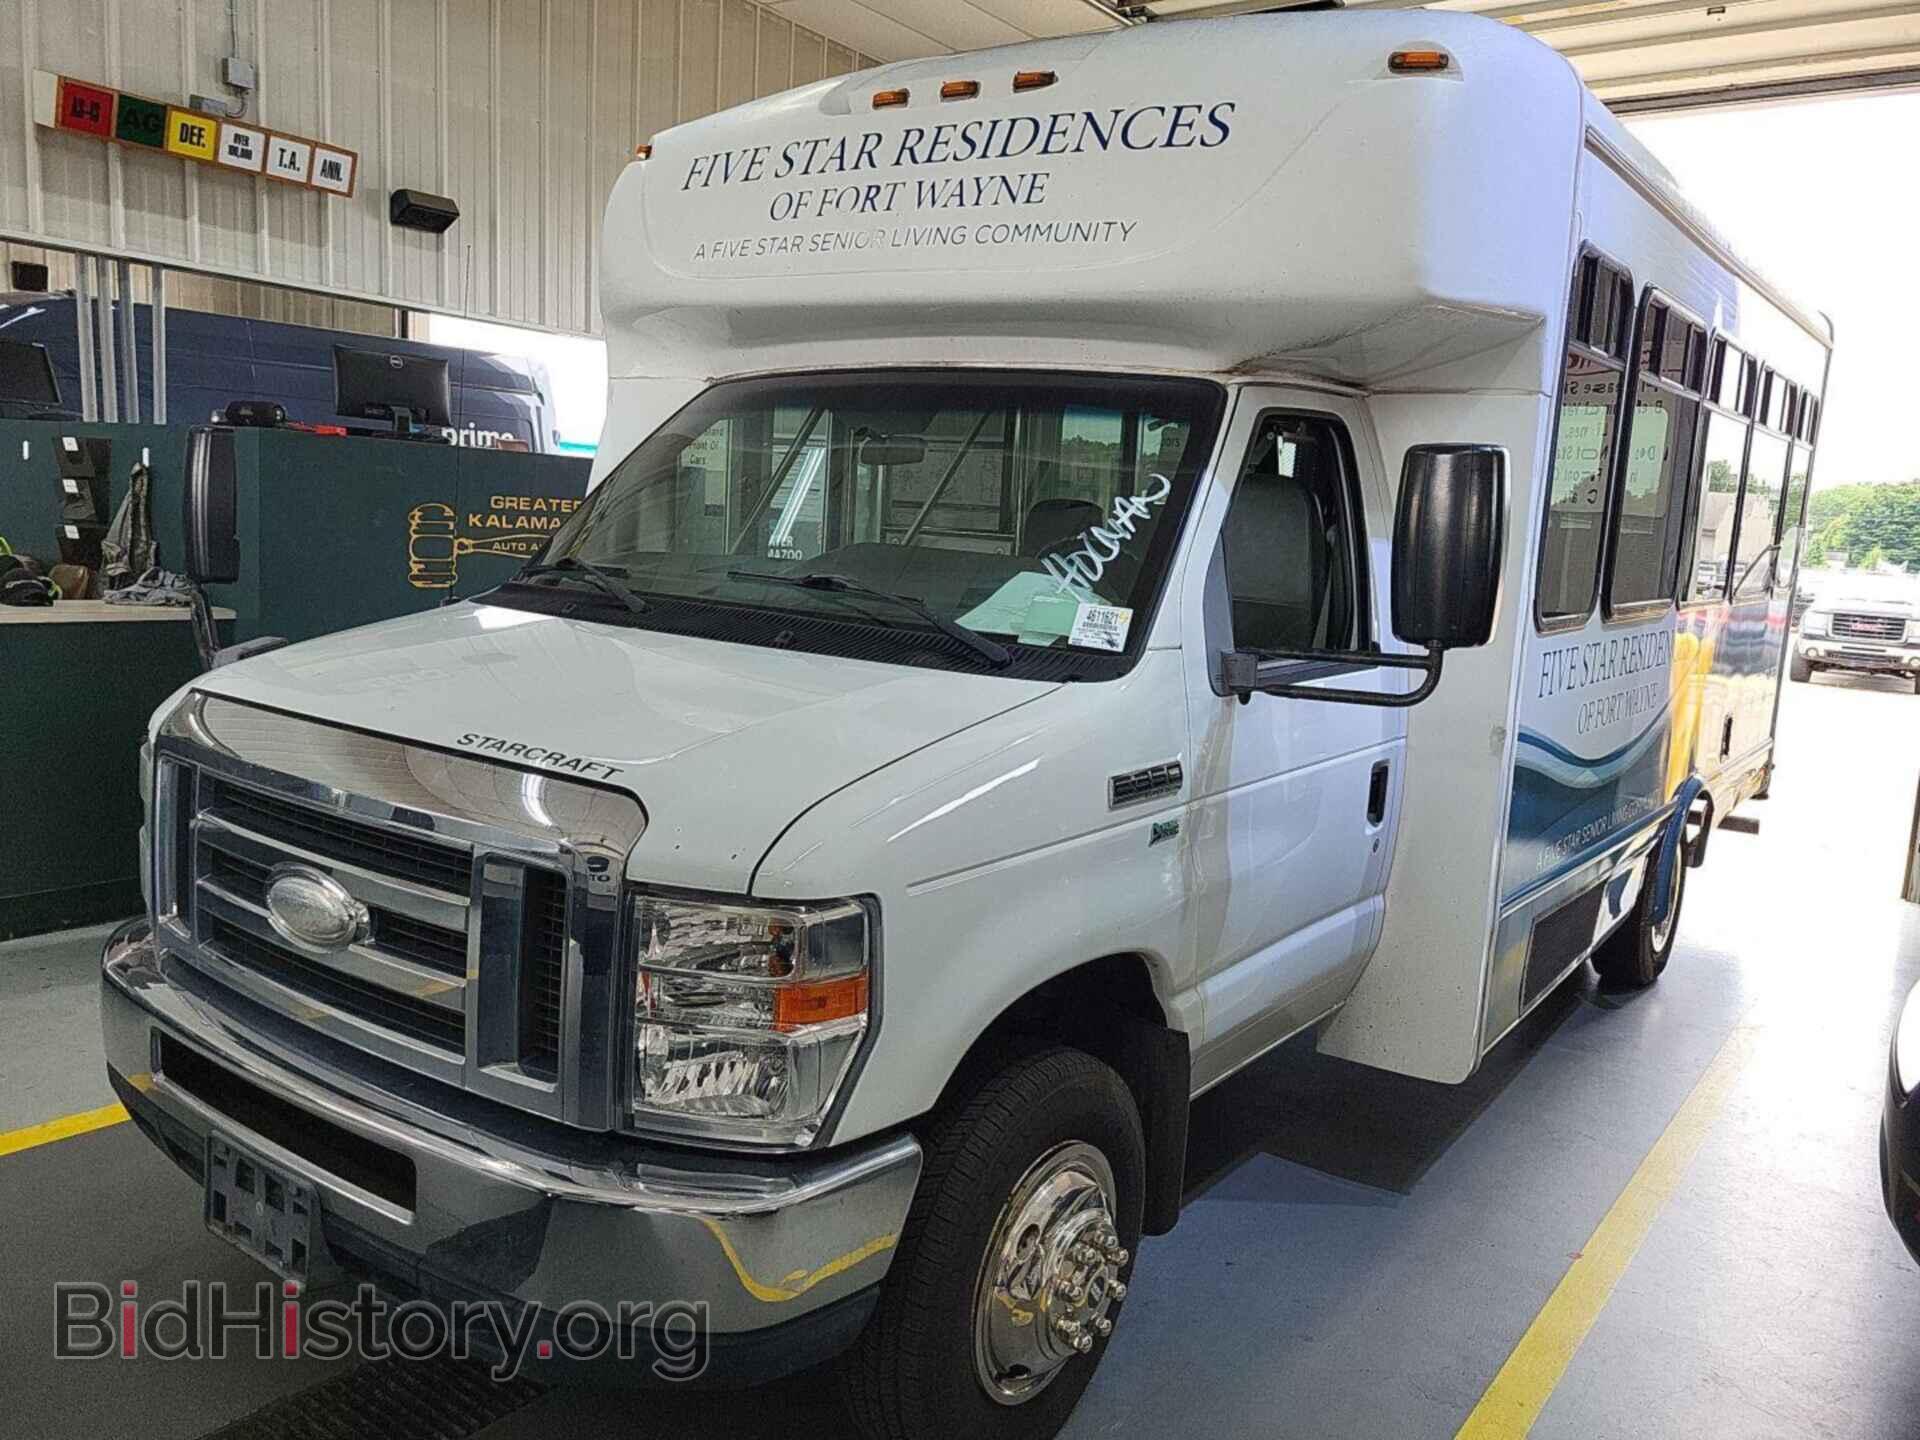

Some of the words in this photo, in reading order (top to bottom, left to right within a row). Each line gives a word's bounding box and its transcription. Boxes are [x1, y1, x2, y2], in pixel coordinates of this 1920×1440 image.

[278, 147, 300, 172] T.A.
[681, 143, 779, 191] FIVE
[774, 131, 884, 179] STAR
[891, 101, 1236, 168] RESIDENCES
[769, 190, 813, 221] OF
[817, 181, 905, 218] FORT
[914, 172, 1050, 211] WAYNE
[693, 244, 706, 261] A
[711, 239, 752, 260] FIVE
[755, 234, 804, 257] STAR
[808, 229, 888, 253] SENIOR
[891, 225, 967, 249] LIVING
[974, 220, 1138, 247] COMMUNITY
[468, 513, 562, 530] KALAMA
[492, 542, 527, 551] AUTO
[1538, 645, 1580, 698] FIVE
[1580, 639, 1618, 687] STAR
[1619, 630, 1673, 676] RESIDEN
[1577, 700, 1596, 735] OF
[1595, 692, 1624, 729] FORT
[456, 733, 625, 780] STARCRAFT
